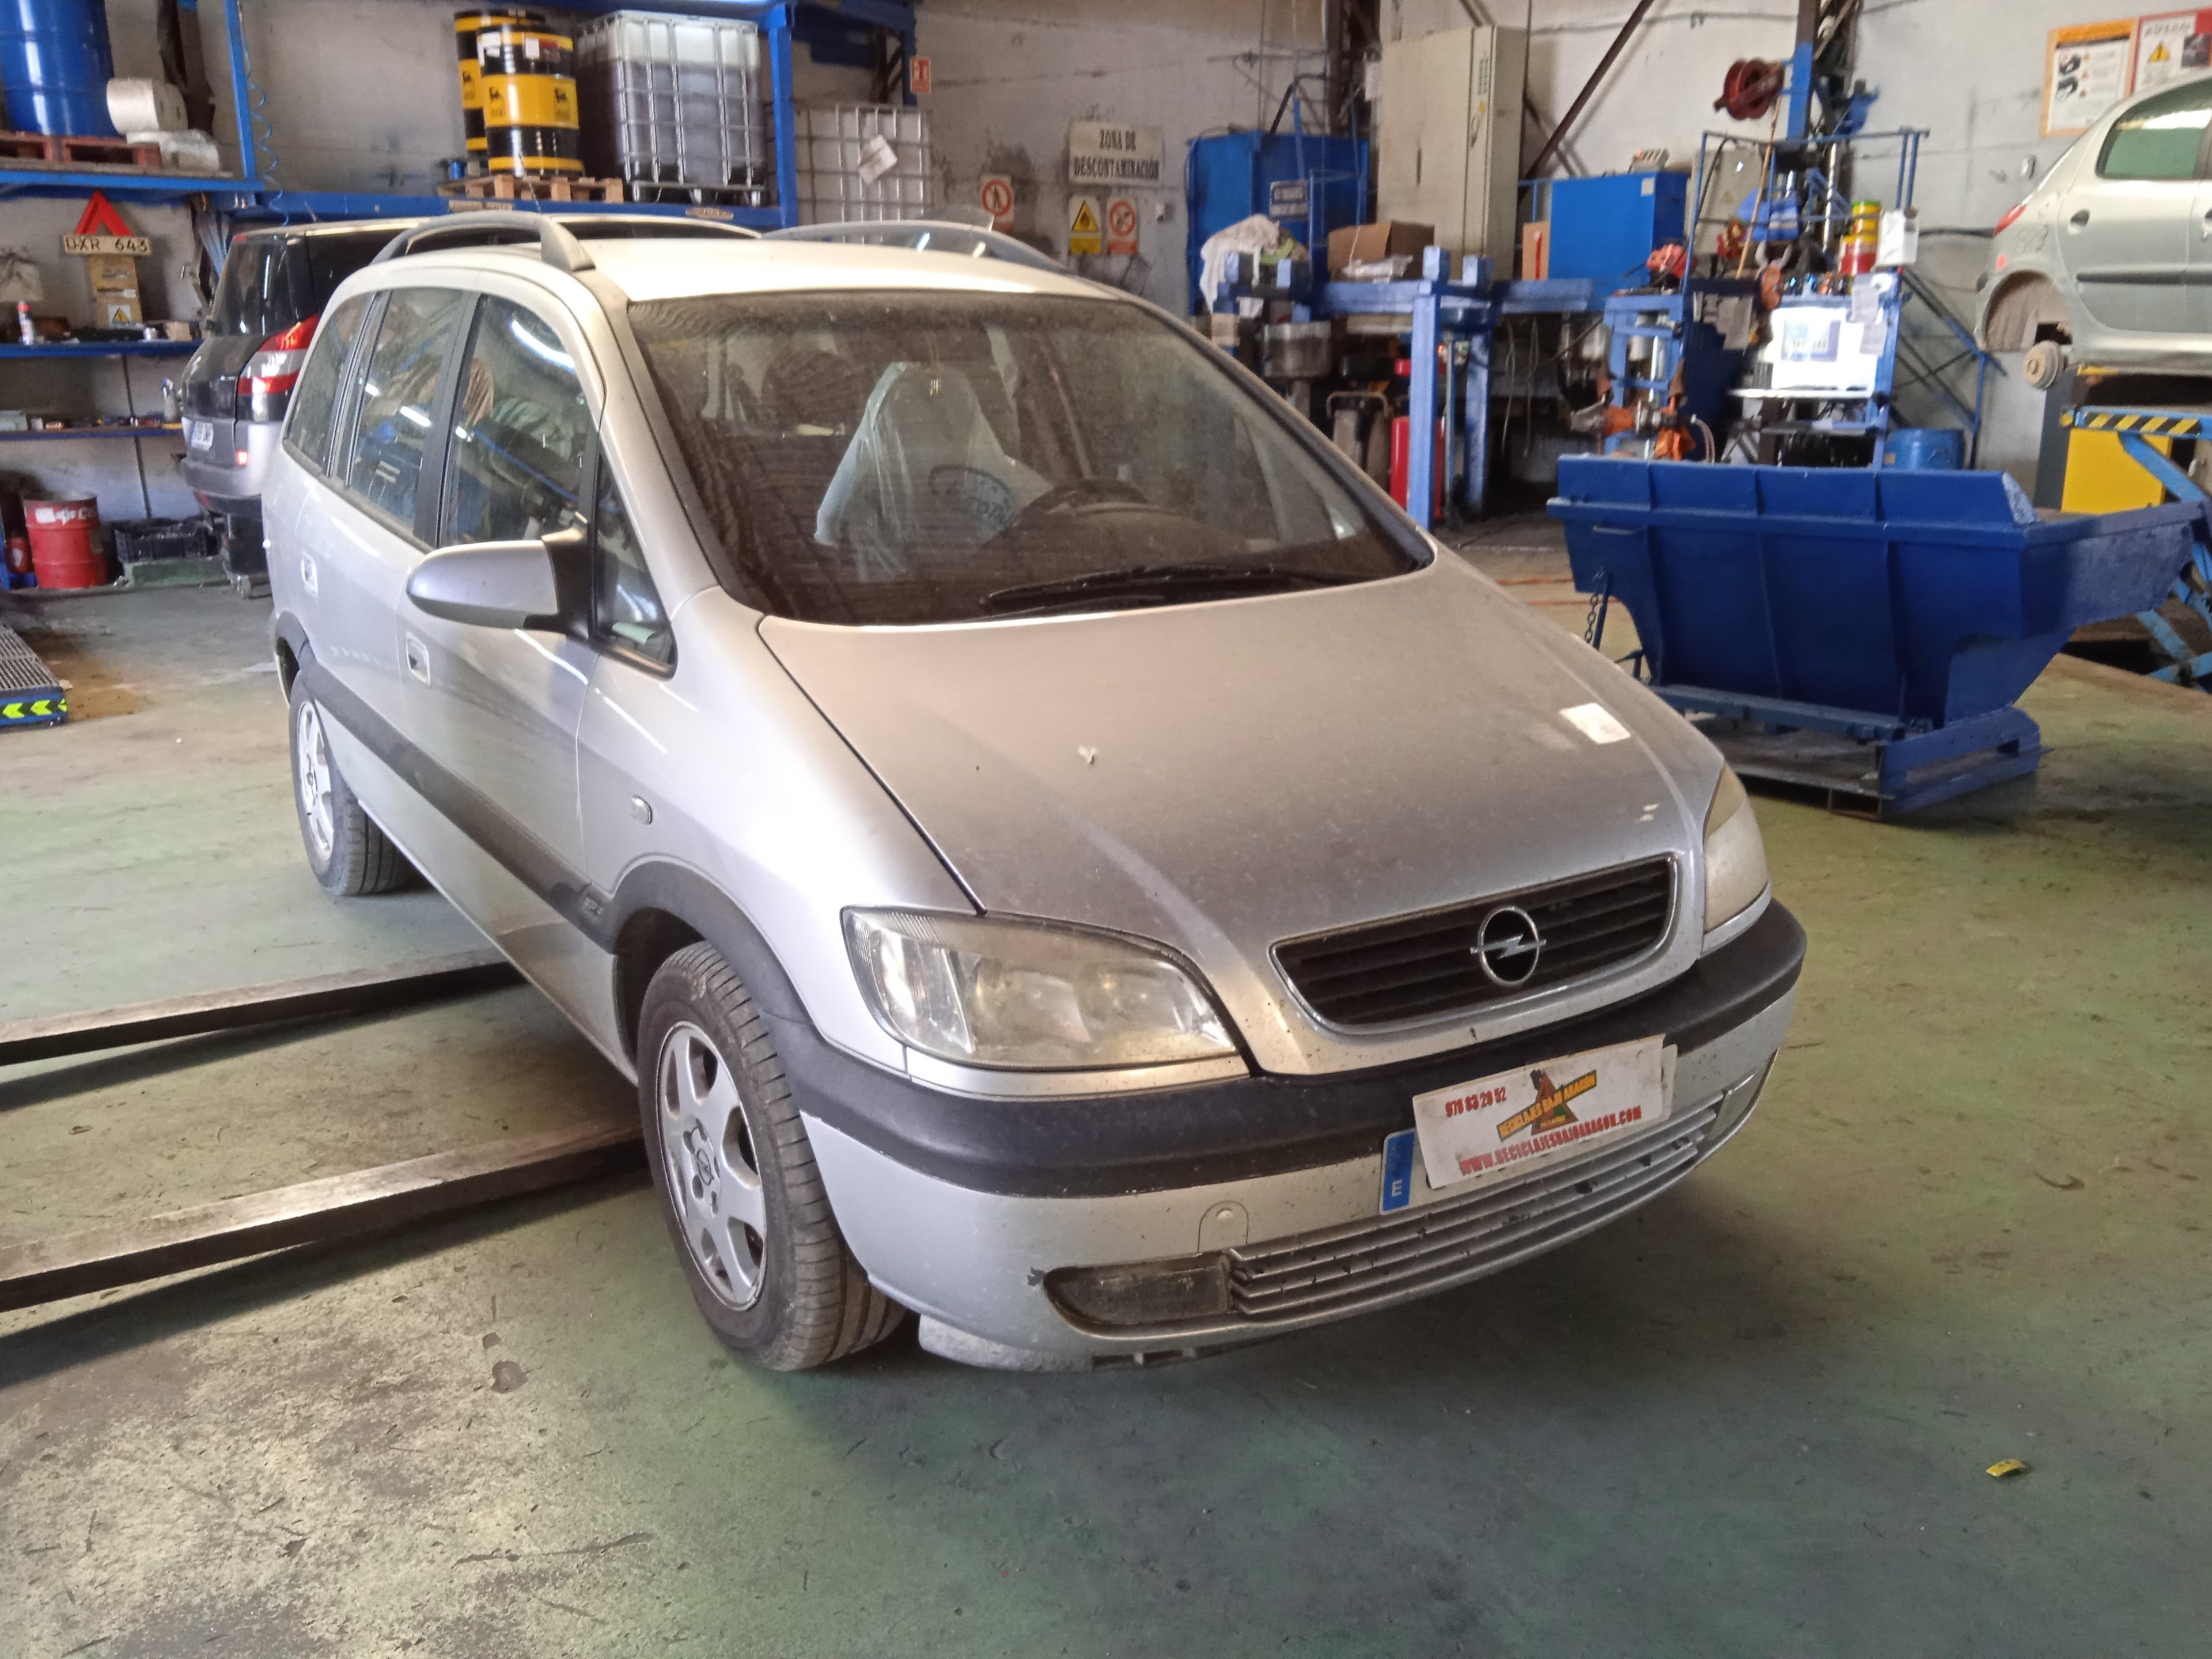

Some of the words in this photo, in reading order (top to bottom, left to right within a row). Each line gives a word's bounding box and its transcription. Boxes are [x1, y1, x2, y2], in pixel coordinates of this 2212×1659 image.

[1099, 129, 1123, 151] ZONA
[1125, 130, 1137, 152] DE
[1074, 155, 1160, 181] DESCONTAMINACIÓN
[1499, 1103, 1543, 1139] RECICLAJES
[1542, 1090, 1563, 1113] BAJO
[1459, 1105, 1642, 1175] WWW.RECICLAJESBAJOARAGON.COM
[1392, 1179, 1402, 1196] E
